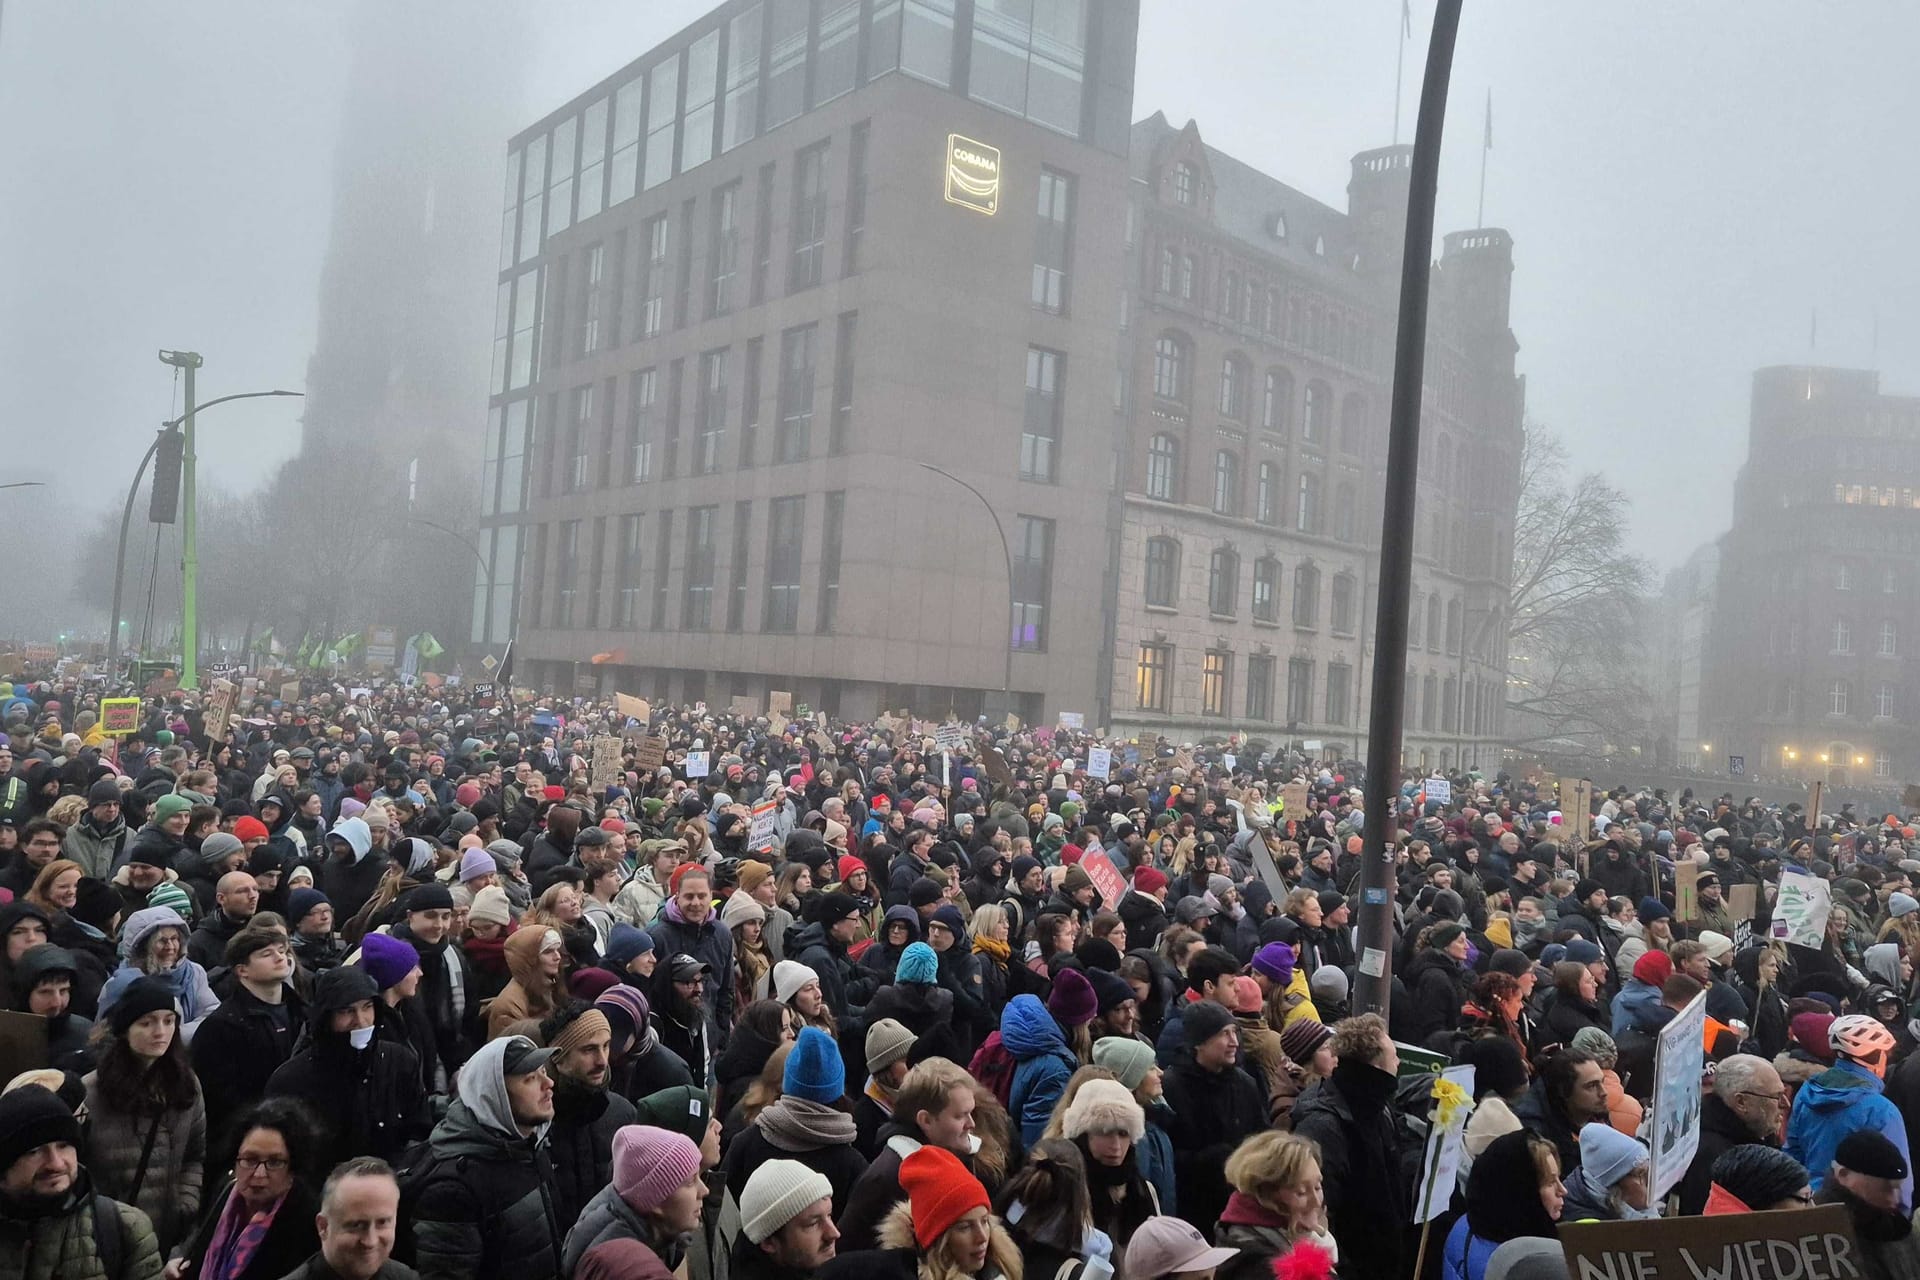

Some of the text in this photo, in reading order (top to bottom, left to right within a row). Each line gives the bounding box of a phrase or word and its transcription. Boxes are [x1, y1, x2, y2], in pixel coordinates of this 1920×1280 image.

[953, 148, 996, 172] COBANA
[1576, 1233, 1861, 1280] NIE WIEDER
